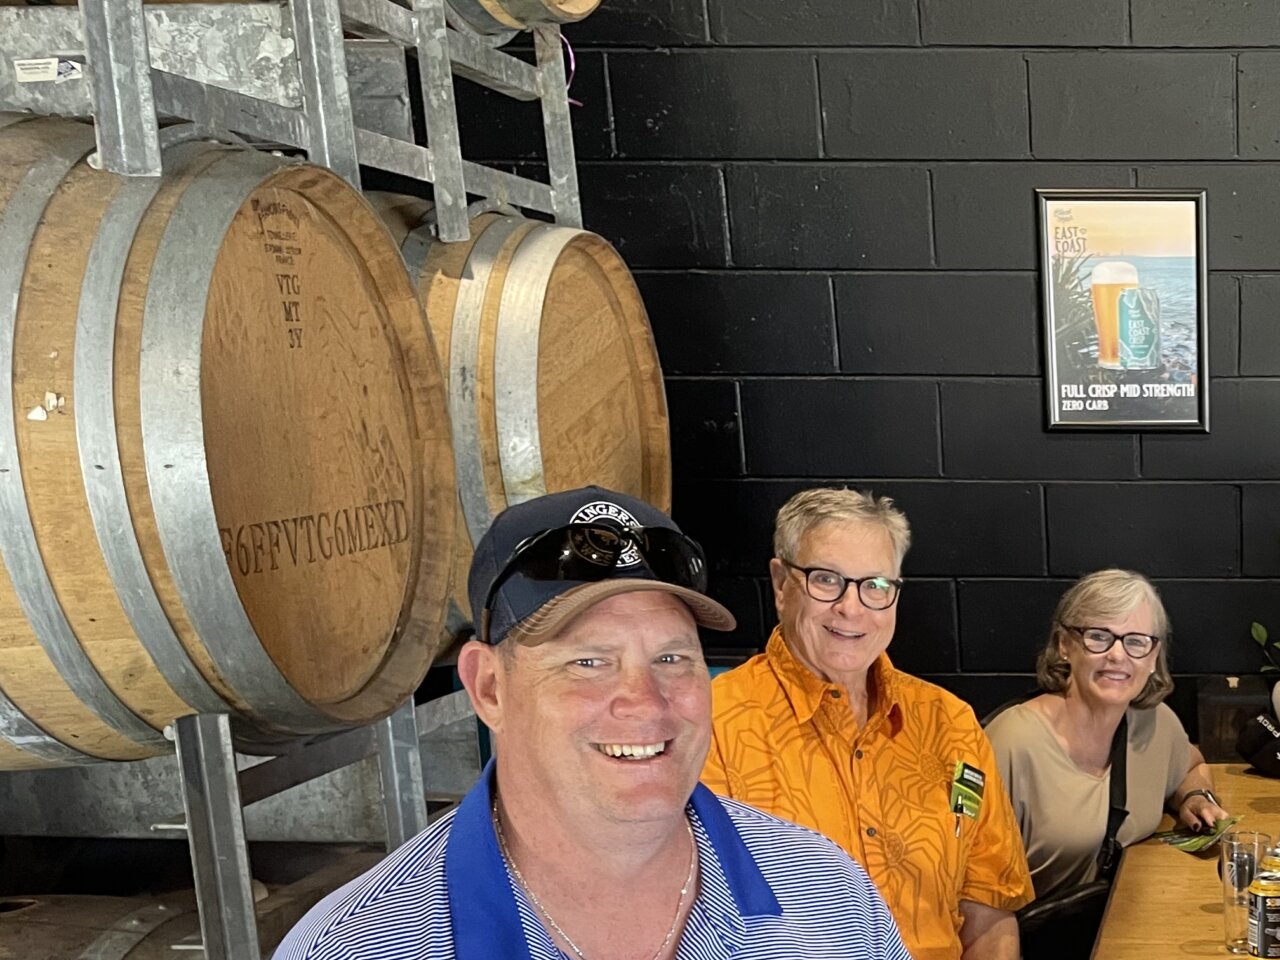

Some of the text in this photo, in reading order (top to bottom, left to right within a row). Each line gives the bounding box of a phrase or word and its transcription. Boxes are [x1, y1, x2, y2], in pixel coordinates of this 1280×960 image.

[1055, 226, 1079, 240] EAST
[1055, 237, 1087, 254] COAST
[276, 274, 300, 295] VTG
[282, 301, 300, 322] MT
[288, 328, 302, 348] 3Y
[1061, 383, 1195, 398] FULL CRISP MID STRENGTH
[1062, 400, 1109, 411] ZERO CARB
